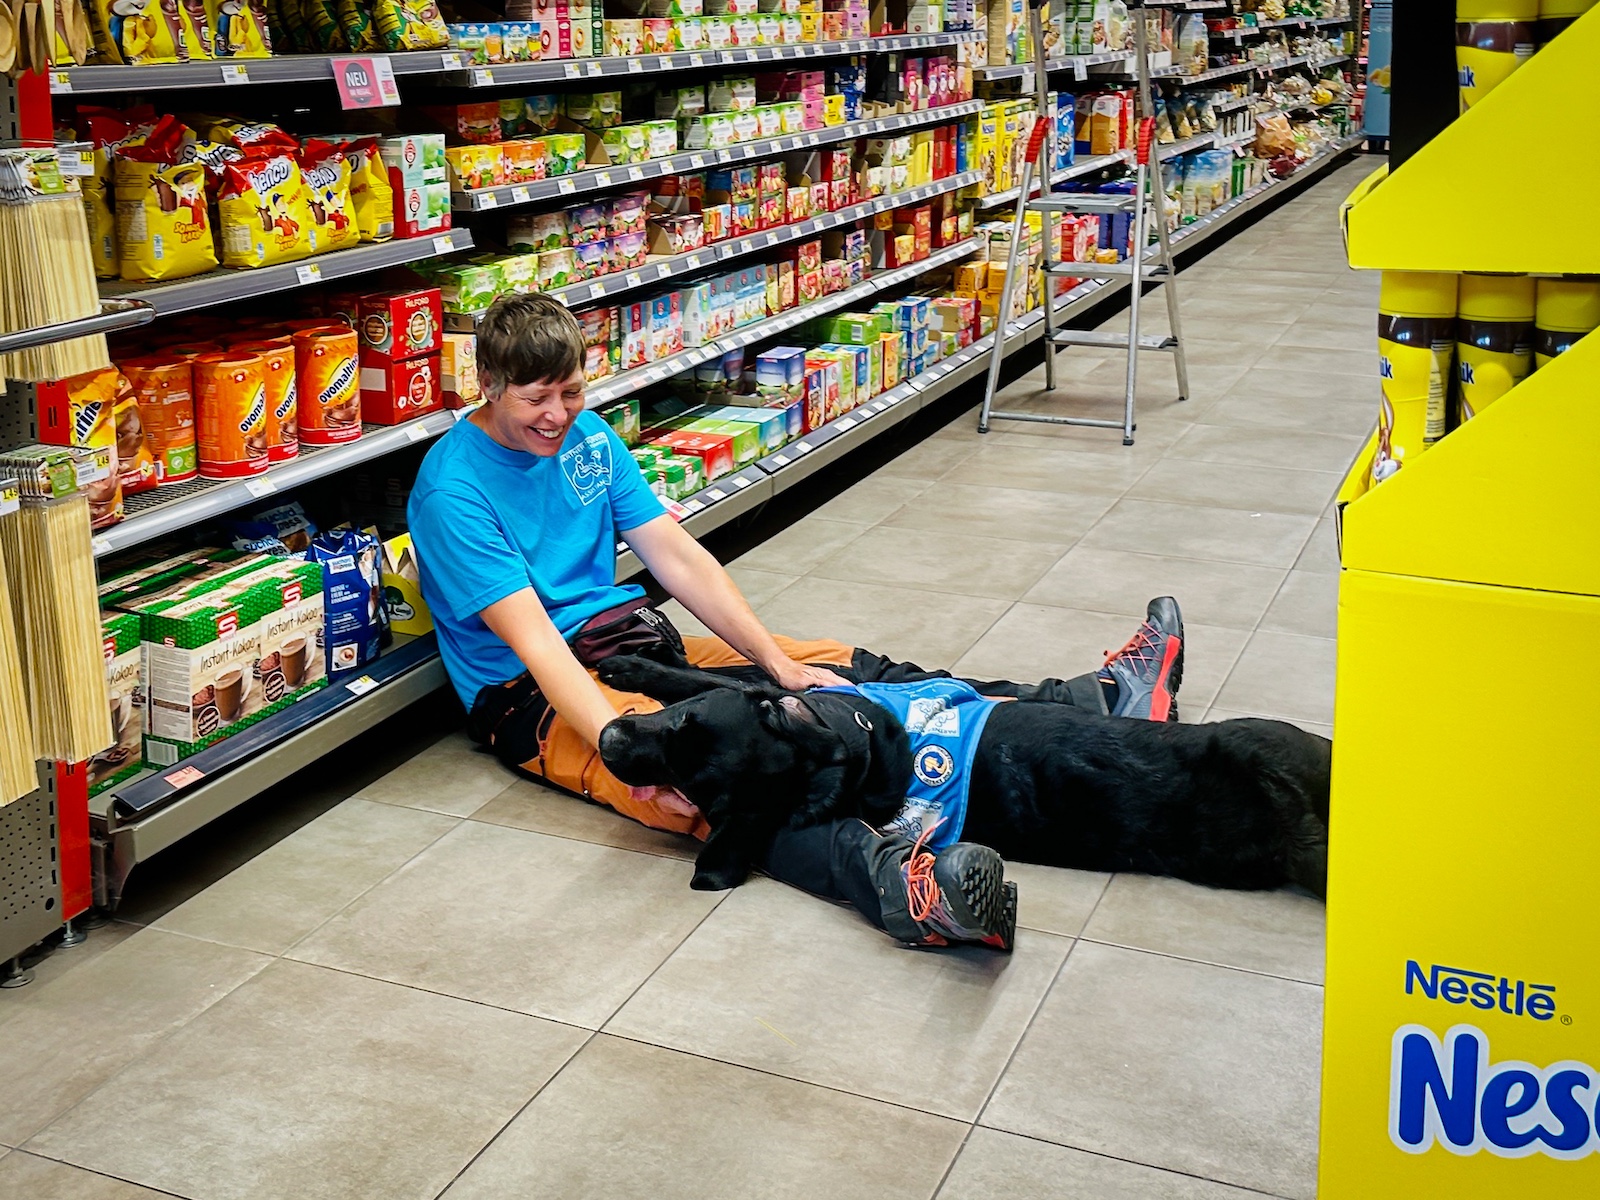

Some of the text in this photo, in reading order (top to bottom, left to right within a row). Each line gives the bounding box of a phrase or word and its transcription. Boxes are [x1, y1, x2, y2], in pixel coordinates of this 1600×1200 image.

[345, 71, 368, 87] NEU
[248, 162, 290, 195] benco
[267, 607, 319, 640] Instant-Kakao
[200, 637, 255, 673] Instant-Kakao
[1398, 1032, 1600, 1152] Nes
